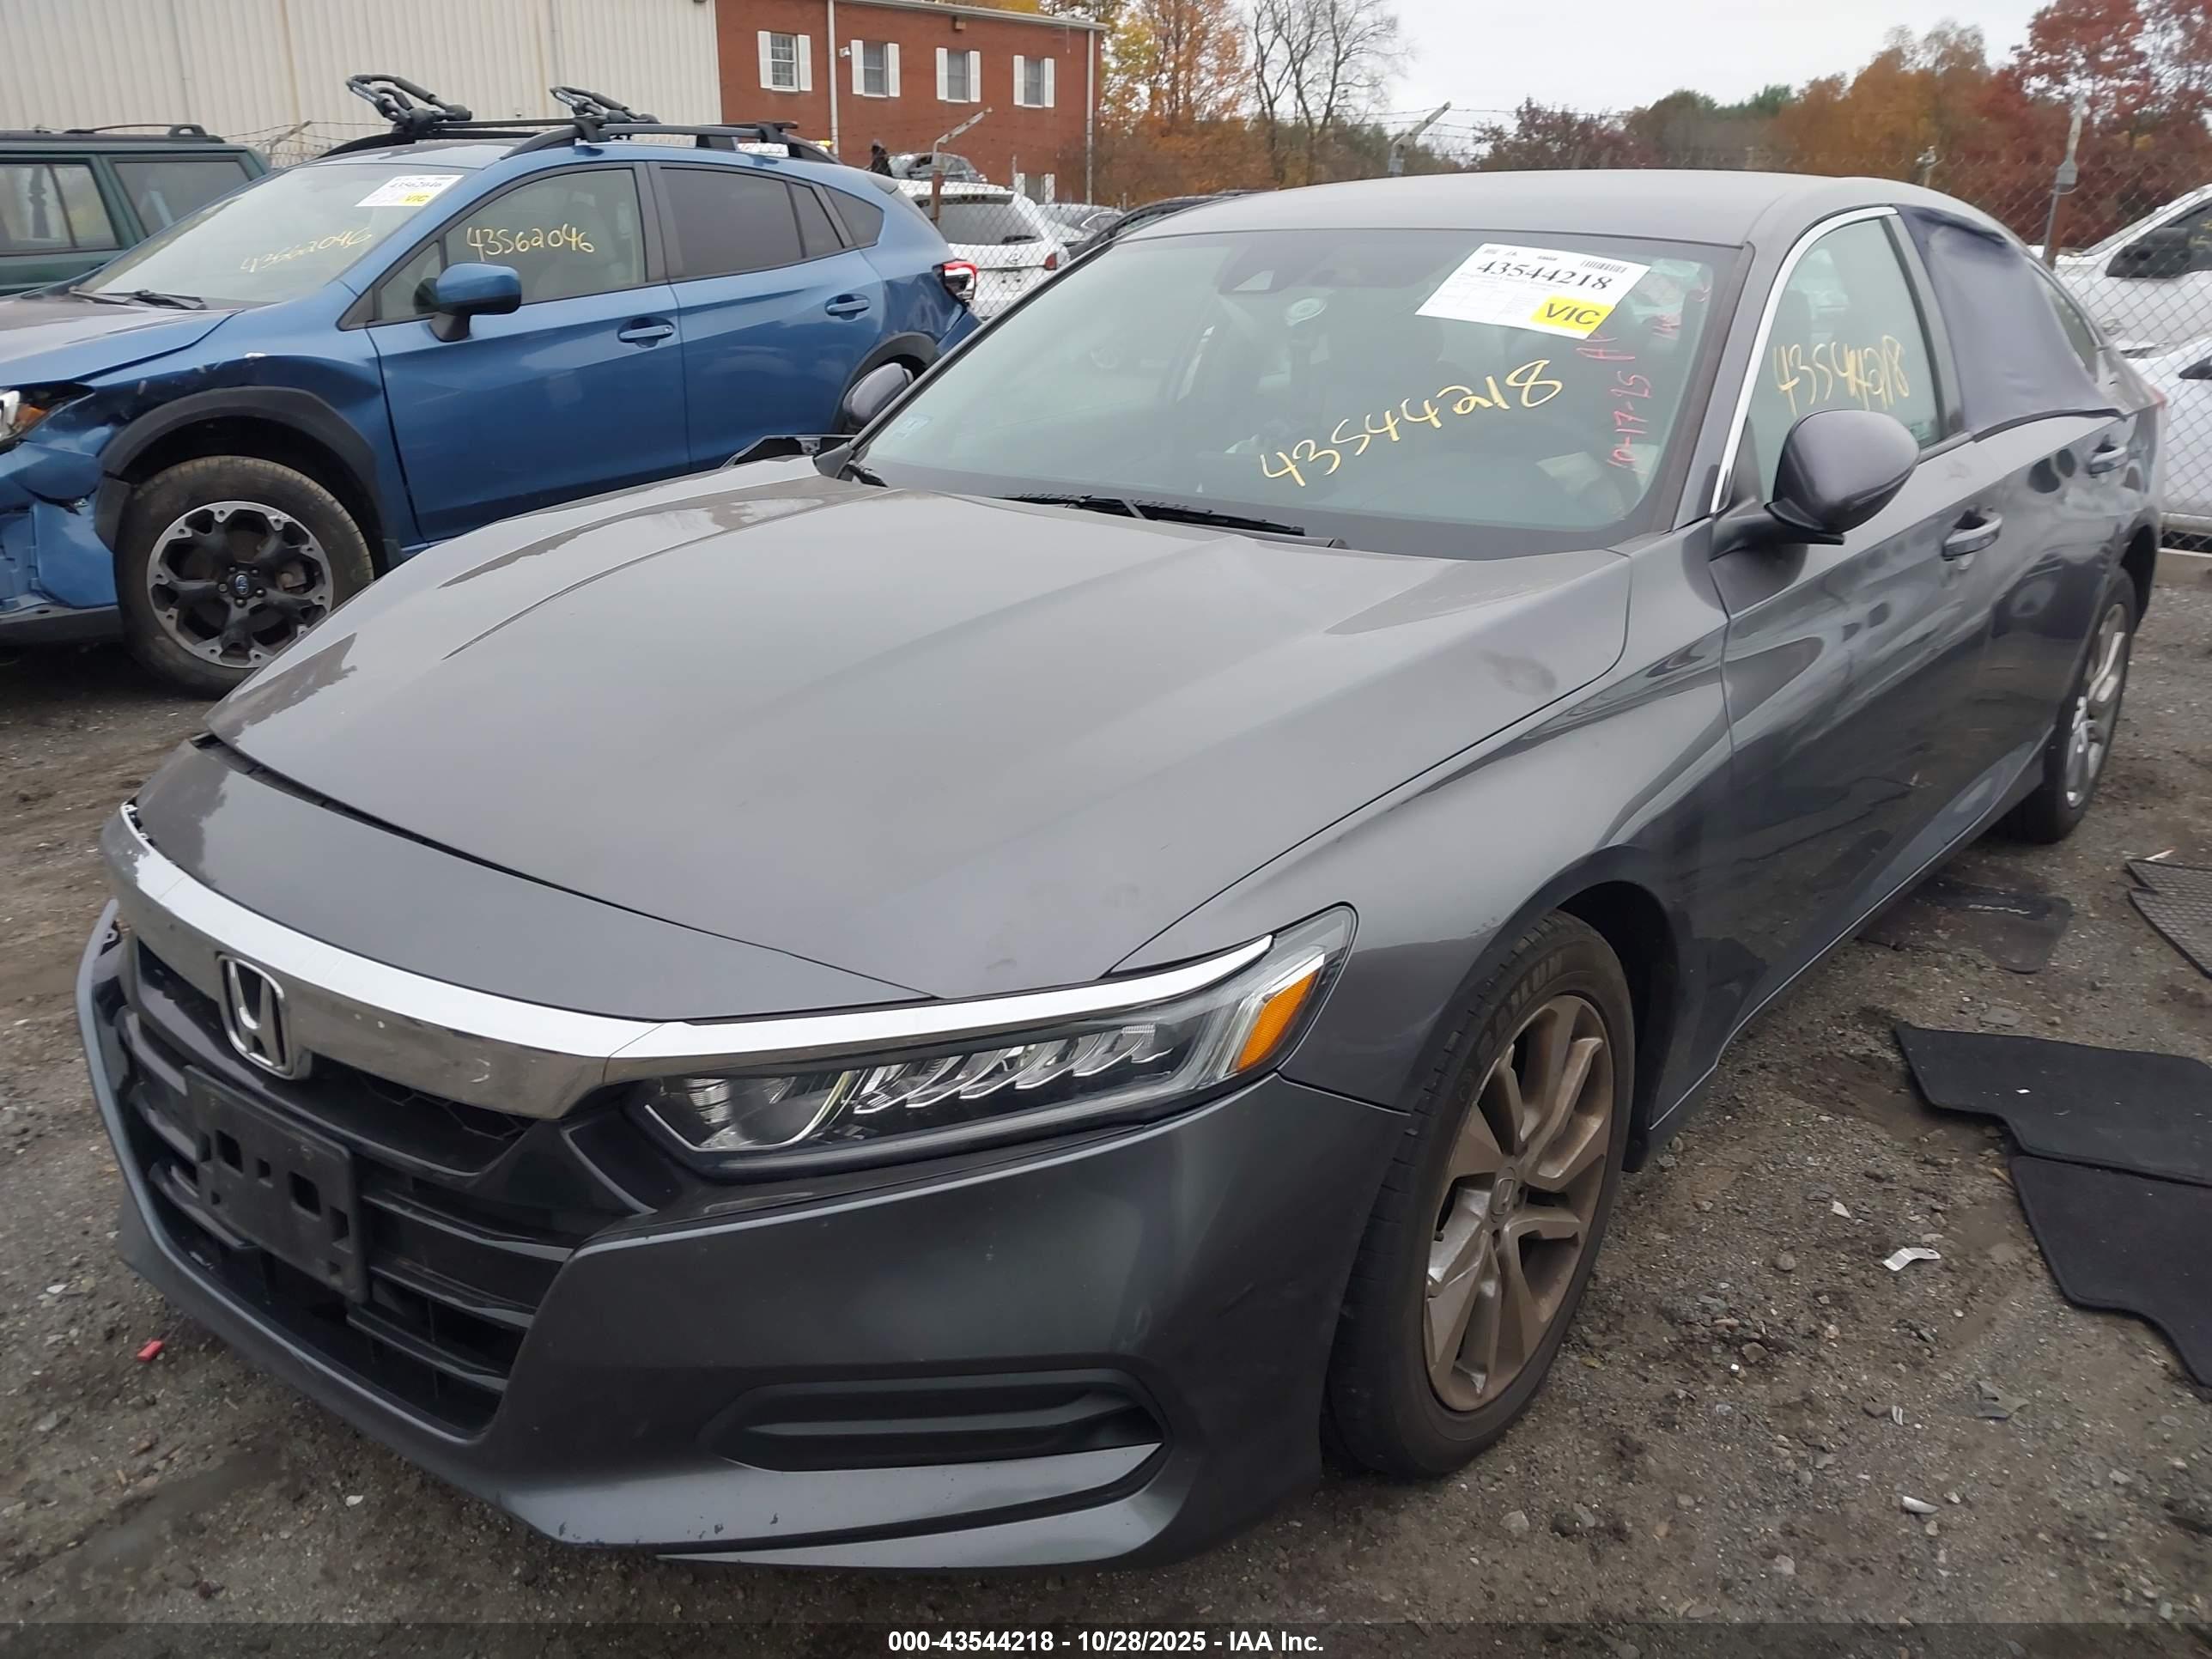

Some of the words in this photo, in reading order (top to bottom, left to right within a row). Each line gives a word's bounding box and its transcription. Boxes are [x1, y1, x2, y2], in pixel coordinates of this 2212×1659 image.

[466, 223, 595, 263] 43562046
[1476, 260, 1613, 290] 43544218
[1546, 302, 1601, 325] VIC
[1260, 359, 1563, 488] 43544218
